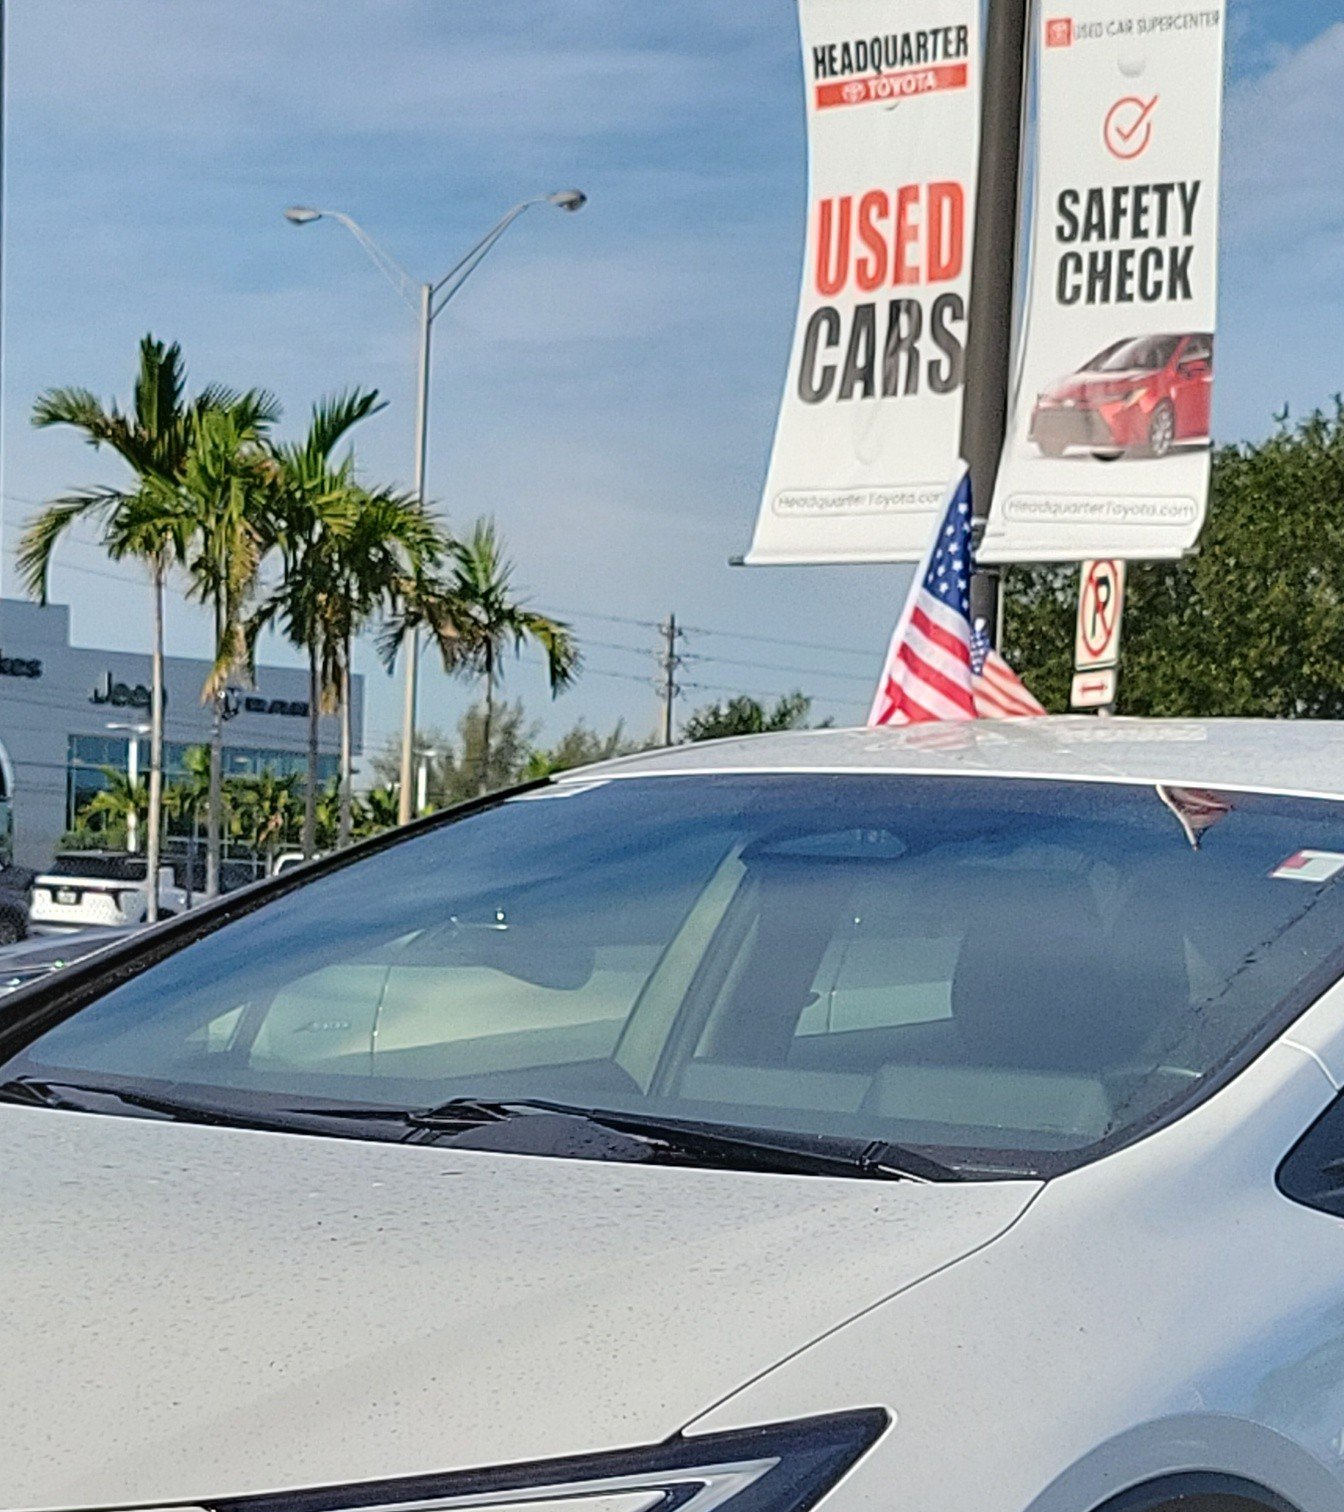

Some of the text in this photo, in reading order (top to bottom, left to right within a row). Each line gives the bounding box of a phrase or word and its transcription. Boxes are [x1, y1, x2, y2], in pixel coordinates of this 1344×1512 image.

[812, 24, 969, 80] HEADQUARTER
[1106, 18, 1133, 36] CAR
[1137, 9, 1220, 35] SUPERCENTER
[867, 70, 937, 98] TOYOTA
[815, 180, 964, 297] USED
[1056, 180, 1201, 244] SAFETY
[1057, 245, 1194, 305] CHECK
[797, 292, 966, 405] CARS
